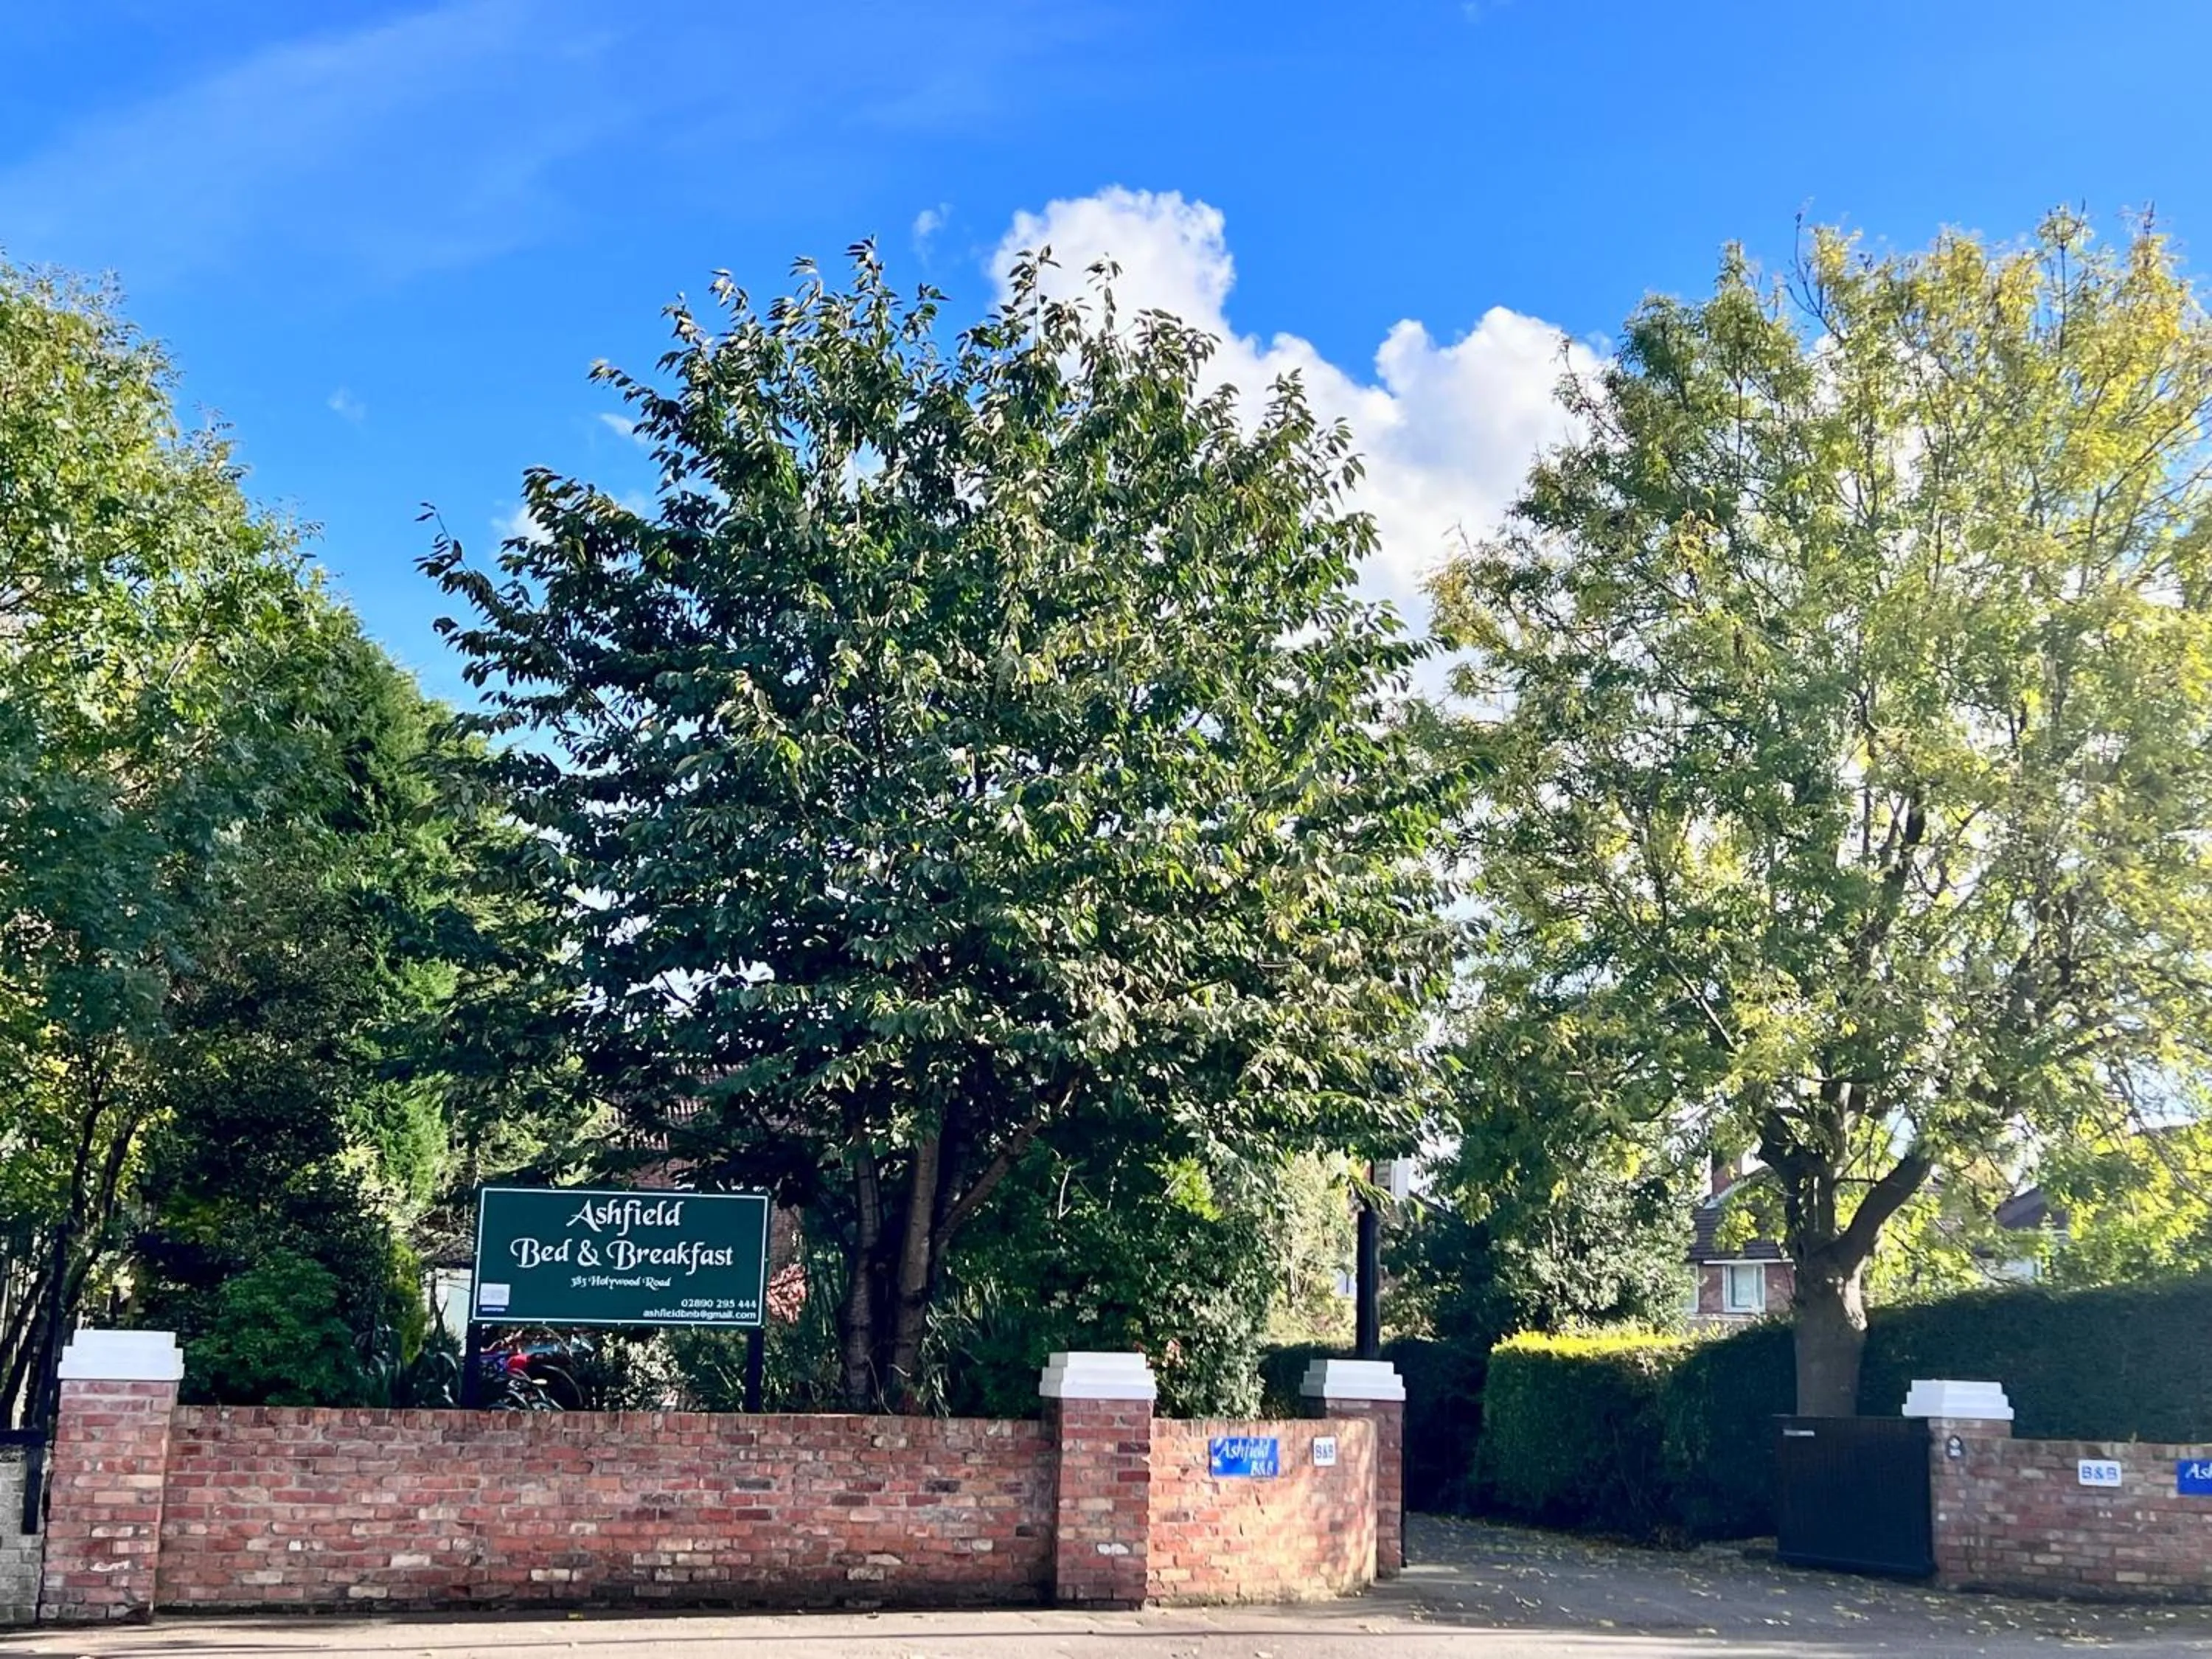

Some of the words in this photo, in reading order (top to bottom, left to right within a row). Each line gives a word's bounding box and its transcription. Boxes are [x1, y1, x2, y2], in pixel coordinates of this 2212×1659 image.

[566, 1198, 684, 1236] Ashfield
[509, 1237, 573, 1269] Bed
[577, 1239, 602, 1267] &
[606, 1239, 734, 1276] Breakfast
[588, 1275, 641, 1290] Holywood
[641, 1276, 672, 1291] Road
[716, 1299, 735, 1308] 295
[737, 1300, 757, 1309] 444
[1217, 1438, 1271, 1463] Ashfield
[1315, 1444, 1334, 1459] B&B
[2081, 1466, 2118, 1480] B&B
